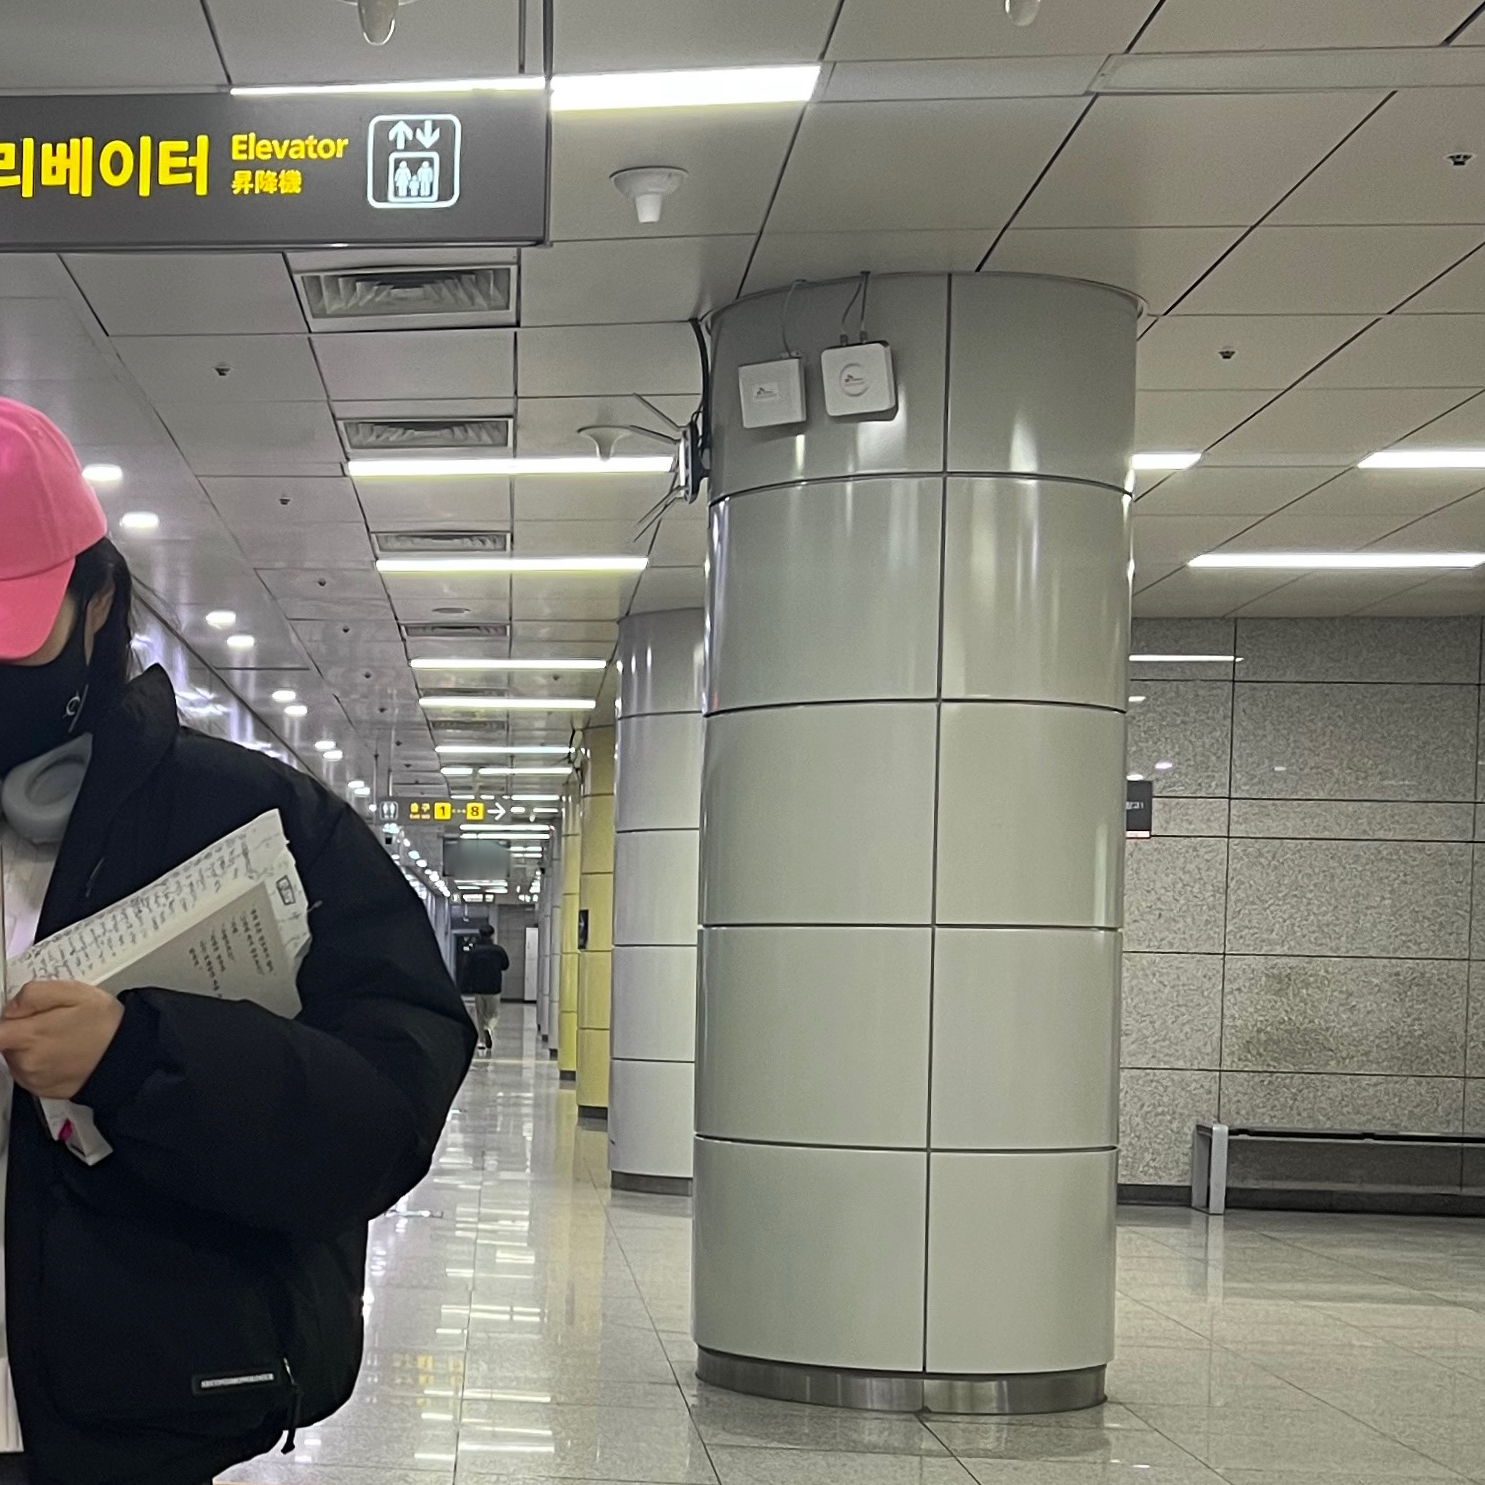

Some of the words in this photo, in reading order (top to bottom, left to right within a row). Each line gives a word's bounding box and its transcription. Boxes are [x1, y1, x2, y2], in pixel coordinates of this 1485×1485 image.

[231, 132, 349, 160] Elevator
[231, 169, 302, 195] 昇降機
